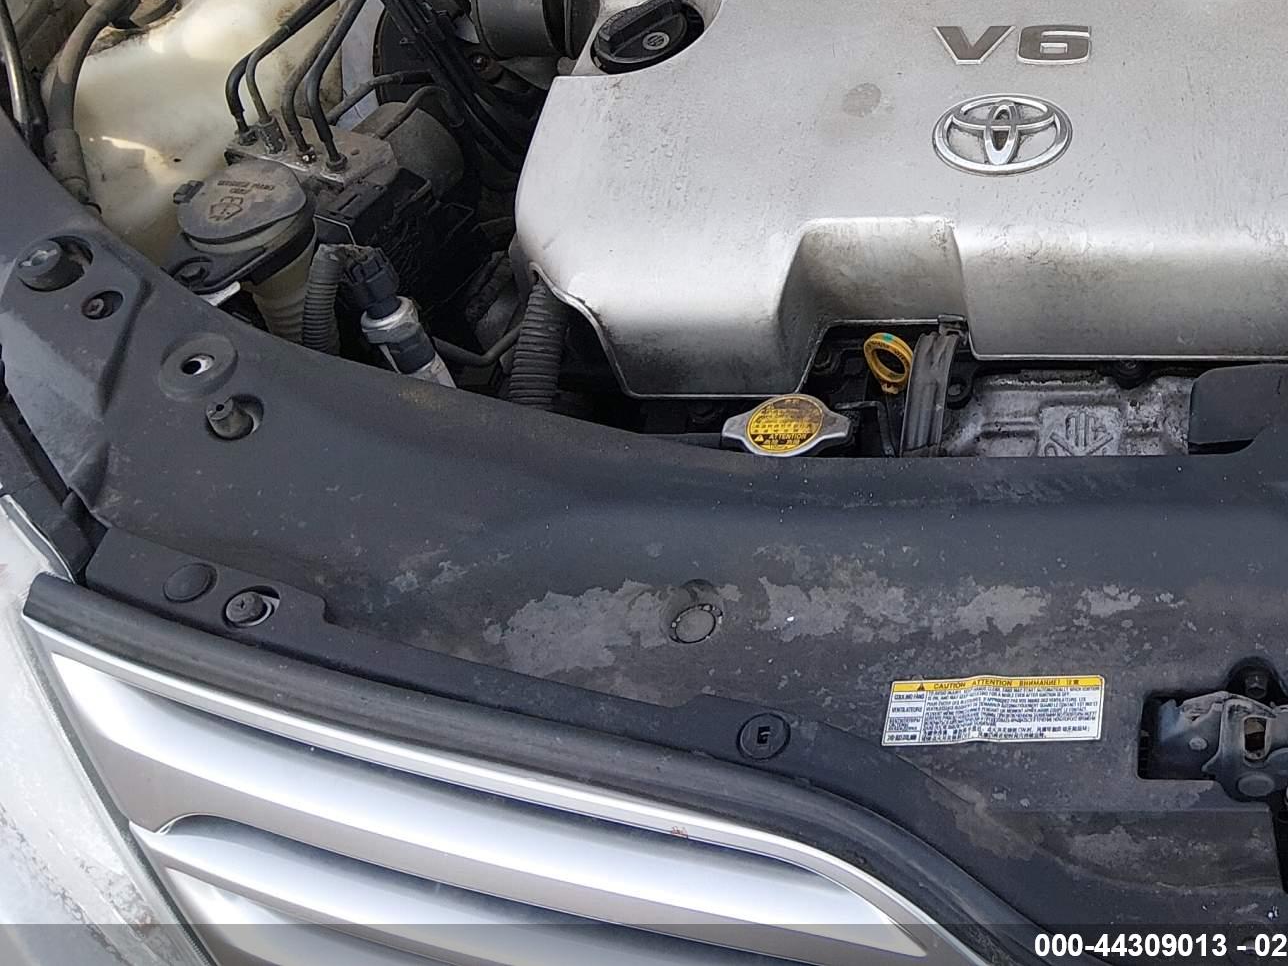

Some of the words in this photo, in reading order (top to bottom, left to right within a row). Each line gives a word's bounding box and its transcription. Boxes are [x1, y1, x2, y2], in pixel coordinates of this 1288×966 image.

[933, 24, 1092, 65] V6
[768, 432, 807, 440] ATTENTION
[933, 681, 966, 690] CAUTION
[972, 678, 1012, 687] ATTENTION
